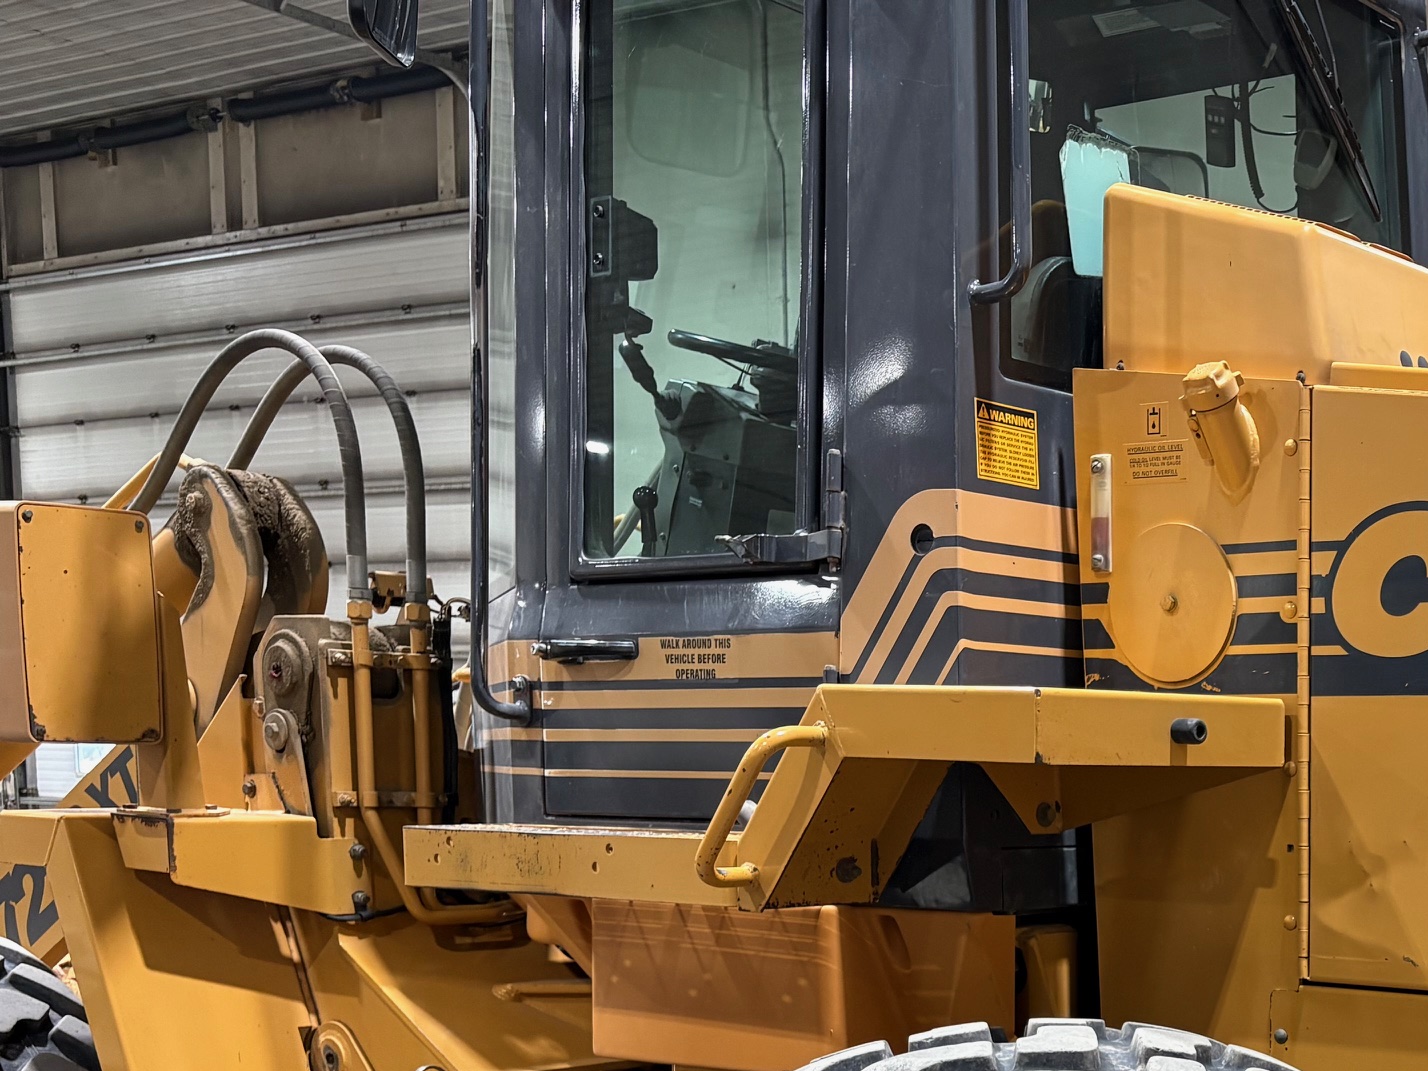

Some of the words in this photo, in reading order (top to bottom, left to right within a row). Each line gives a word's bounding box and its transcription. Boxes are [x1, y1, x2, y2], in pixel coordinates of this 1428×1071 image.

[990, 410, 1034, 429] WARNING
[660, 639, 680, 649] WALK
[682, 638, 711, 649] AROUND
[714, 638, 731, 649] THIS
[665, 654, 695, 664] VEHICLE
[698, 653, 726, 664] BEFORE
[676, 669, 716, 680] OPERATING
